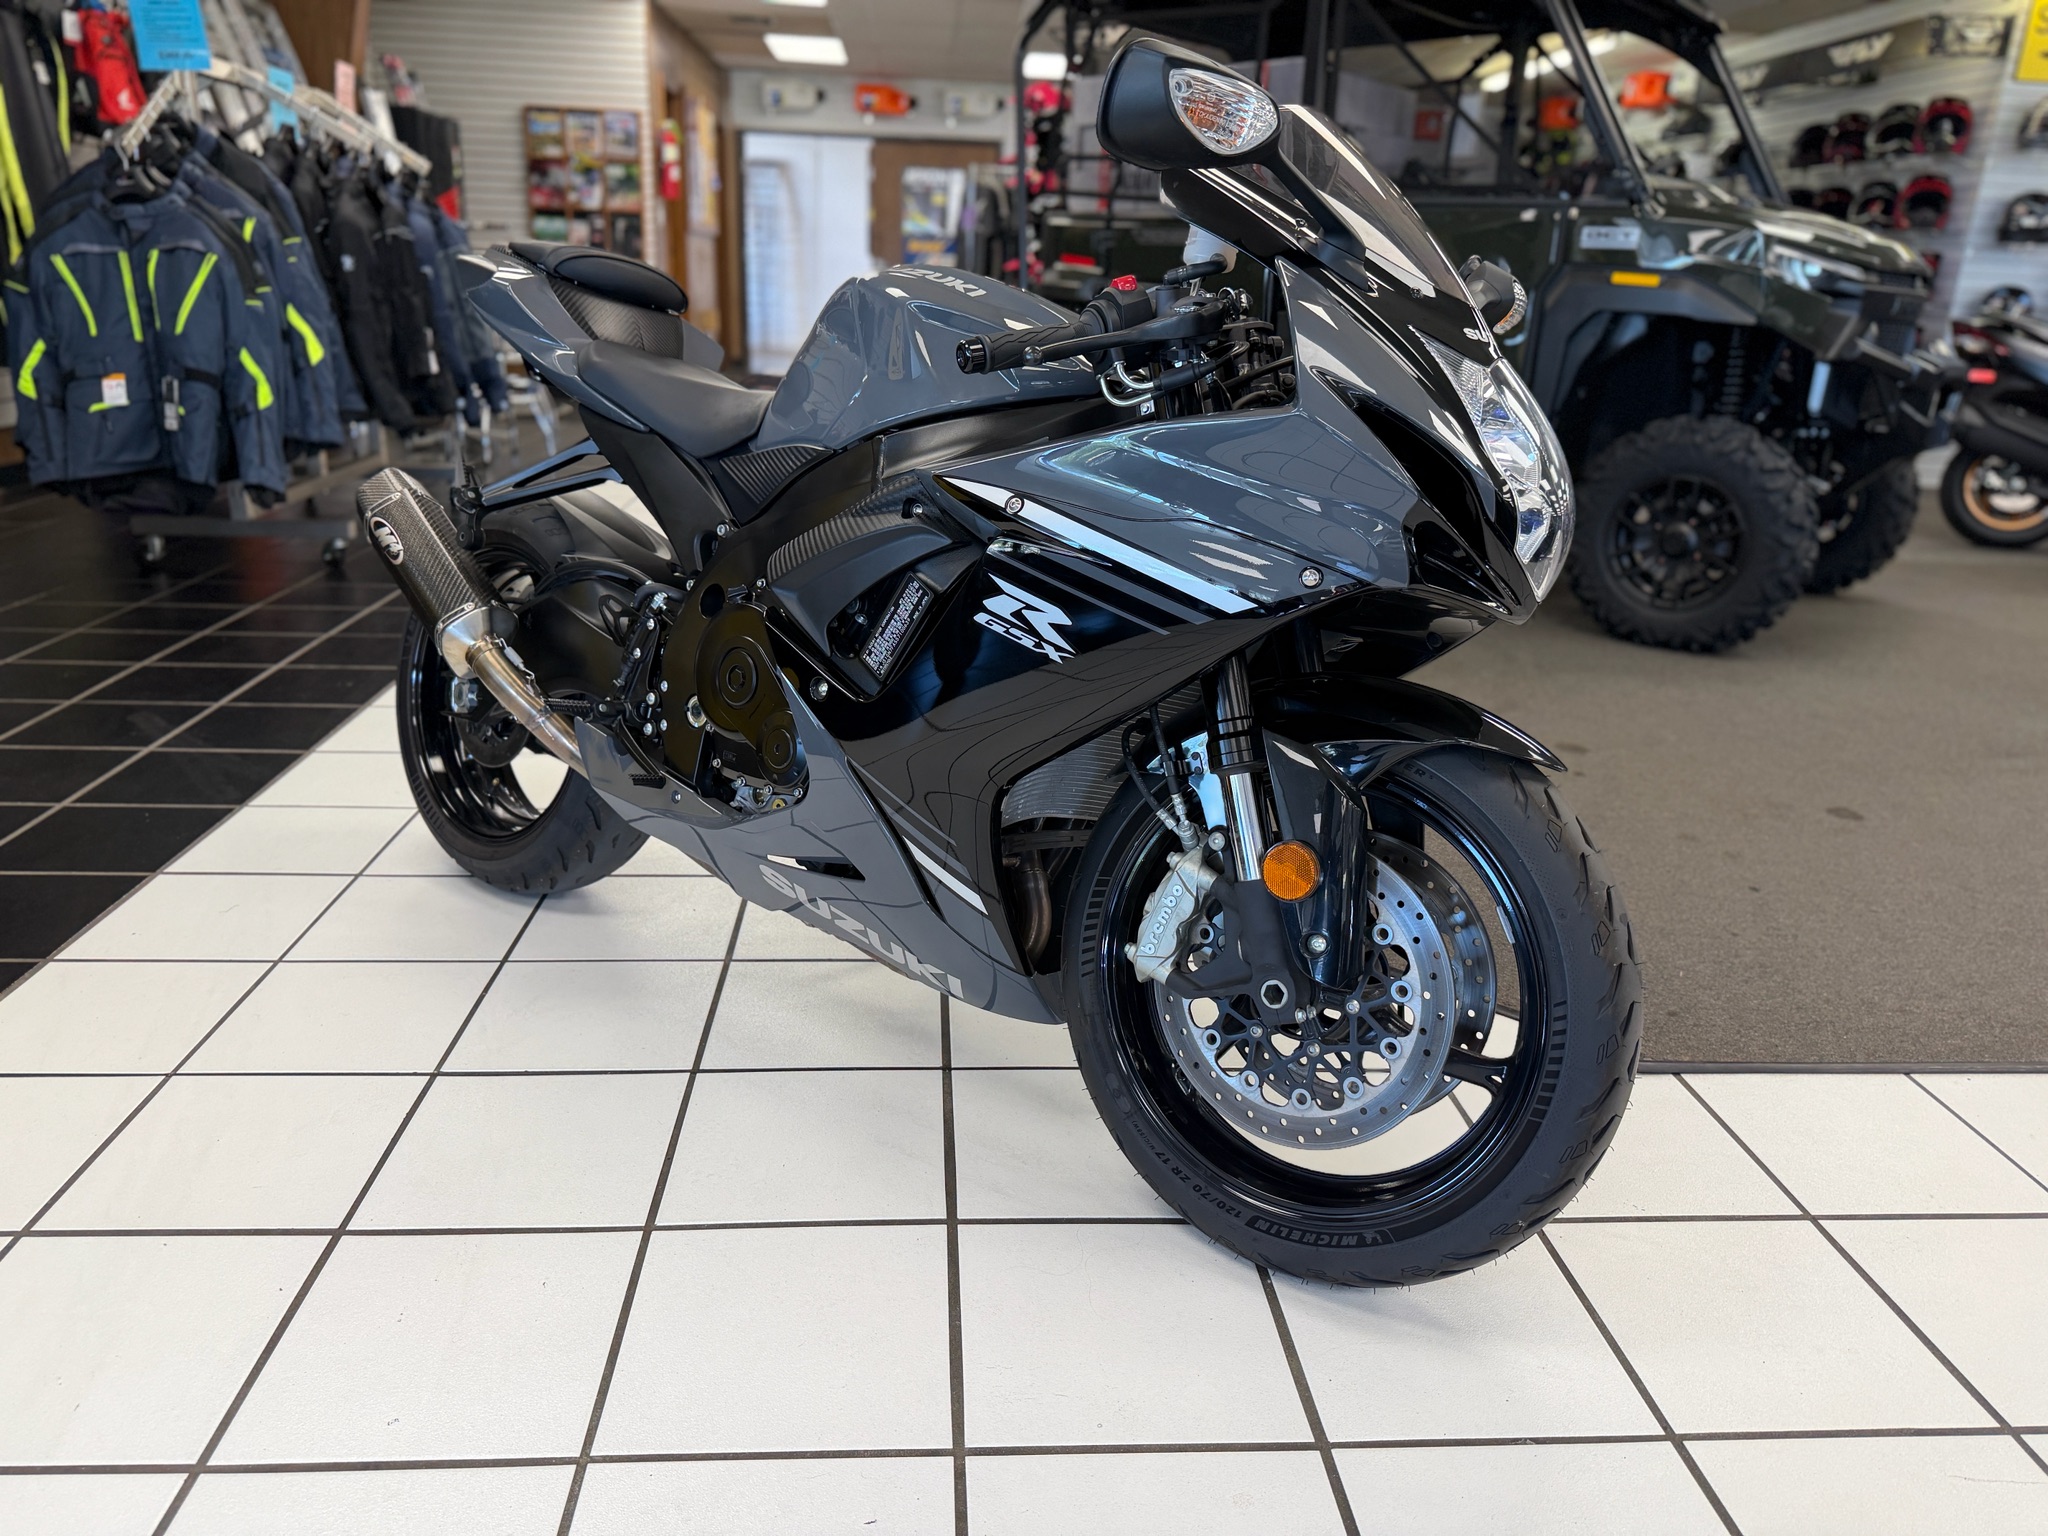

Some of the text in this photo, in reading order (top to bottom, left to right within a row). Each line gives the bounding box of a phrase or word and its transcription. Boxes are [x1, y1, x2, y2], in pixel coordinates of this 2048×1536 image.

[973, 611, 1075, 664] GSX
[759, 864, 965, 999] SUZUKI
[1140, 884, 1183, 955] brembo
[1155, 1151, 1171, 1165] 17
[1171, 1166, 1191, 1183] ZR
[1192, 1184, 1242, 1218] 120/70
[1255, 1219, 1358, 1247] MICHELIN
